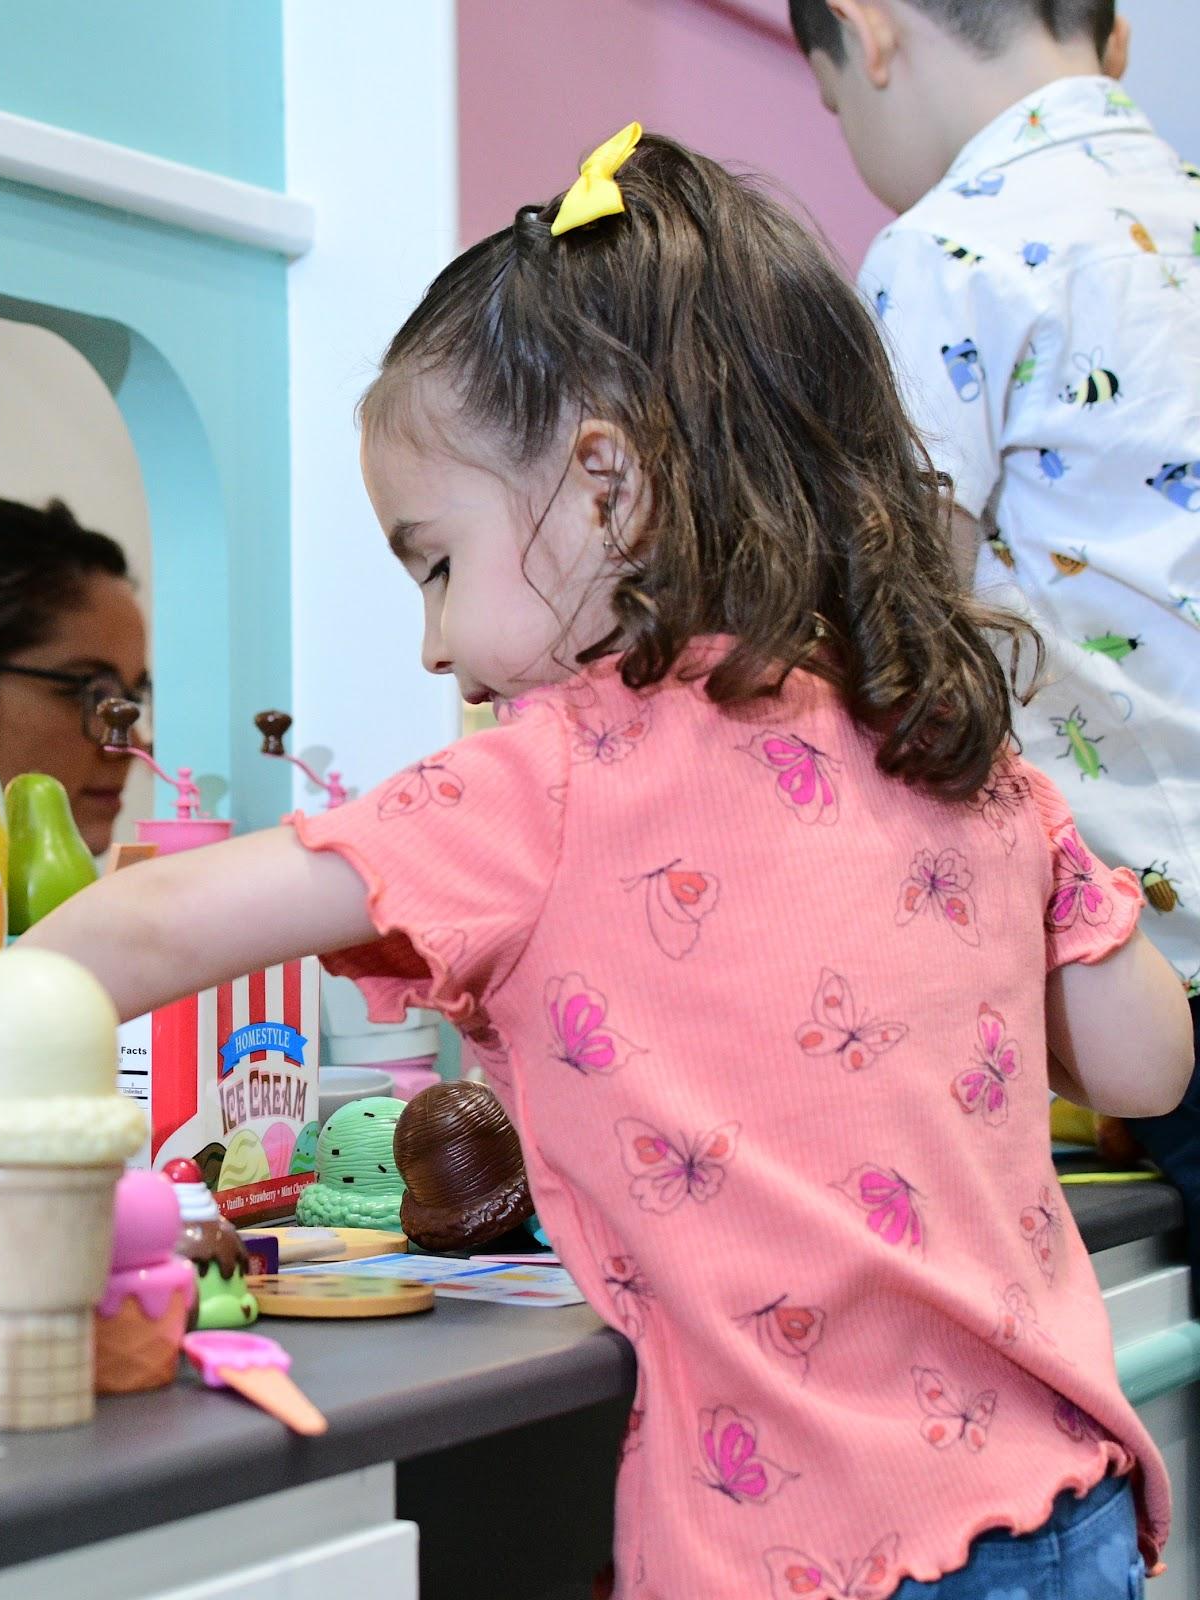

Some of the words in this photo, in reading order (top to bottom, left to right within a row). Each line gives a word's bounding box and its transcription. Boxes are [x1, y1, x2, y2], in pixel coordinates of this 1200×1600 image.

[120, 1046, 148, 1056] Facts
[234, 1026, 291, 1054] HOMESTYLE
[219, 1080, 247, 1136] ICE
[249, 1069, 308, 1122] CREAM
[226, 1194, 245, 1211] Vanilla
[249, 1188, 277, 1206] Strawberry
[281, 1185, 293, 1198] Mint
